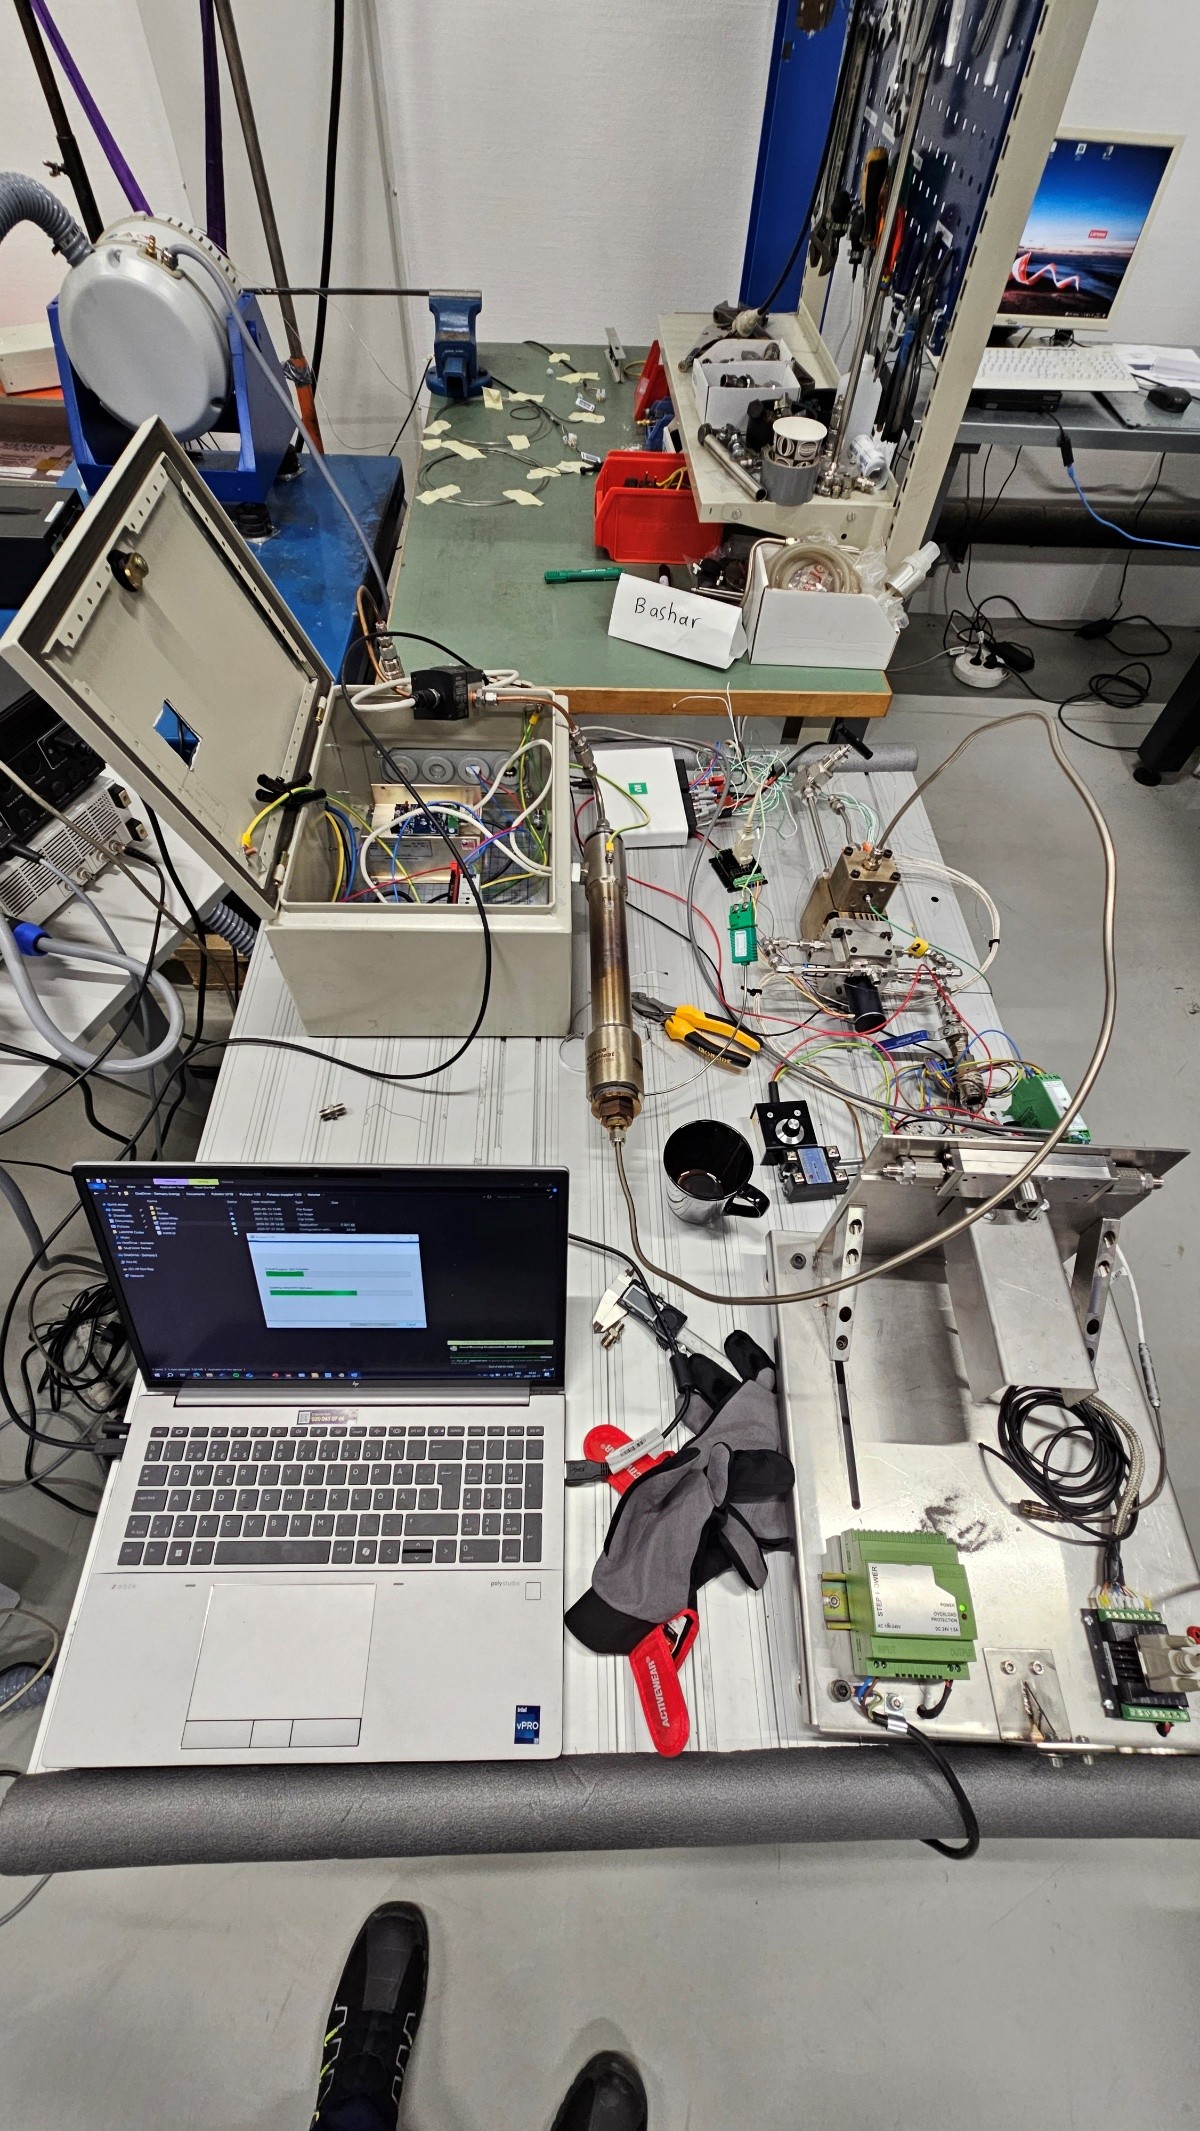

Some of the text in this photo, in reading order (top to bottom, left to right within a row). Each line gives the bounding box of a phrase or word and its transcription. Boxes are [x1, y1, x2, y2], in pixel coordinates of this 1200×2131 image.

[634, 597, 702, 629] Bashar
[912, 943, 922, 952] 2
[876, 1597, 884, 1617] STEP
[516, 1721, 539, 1730] vPRO
